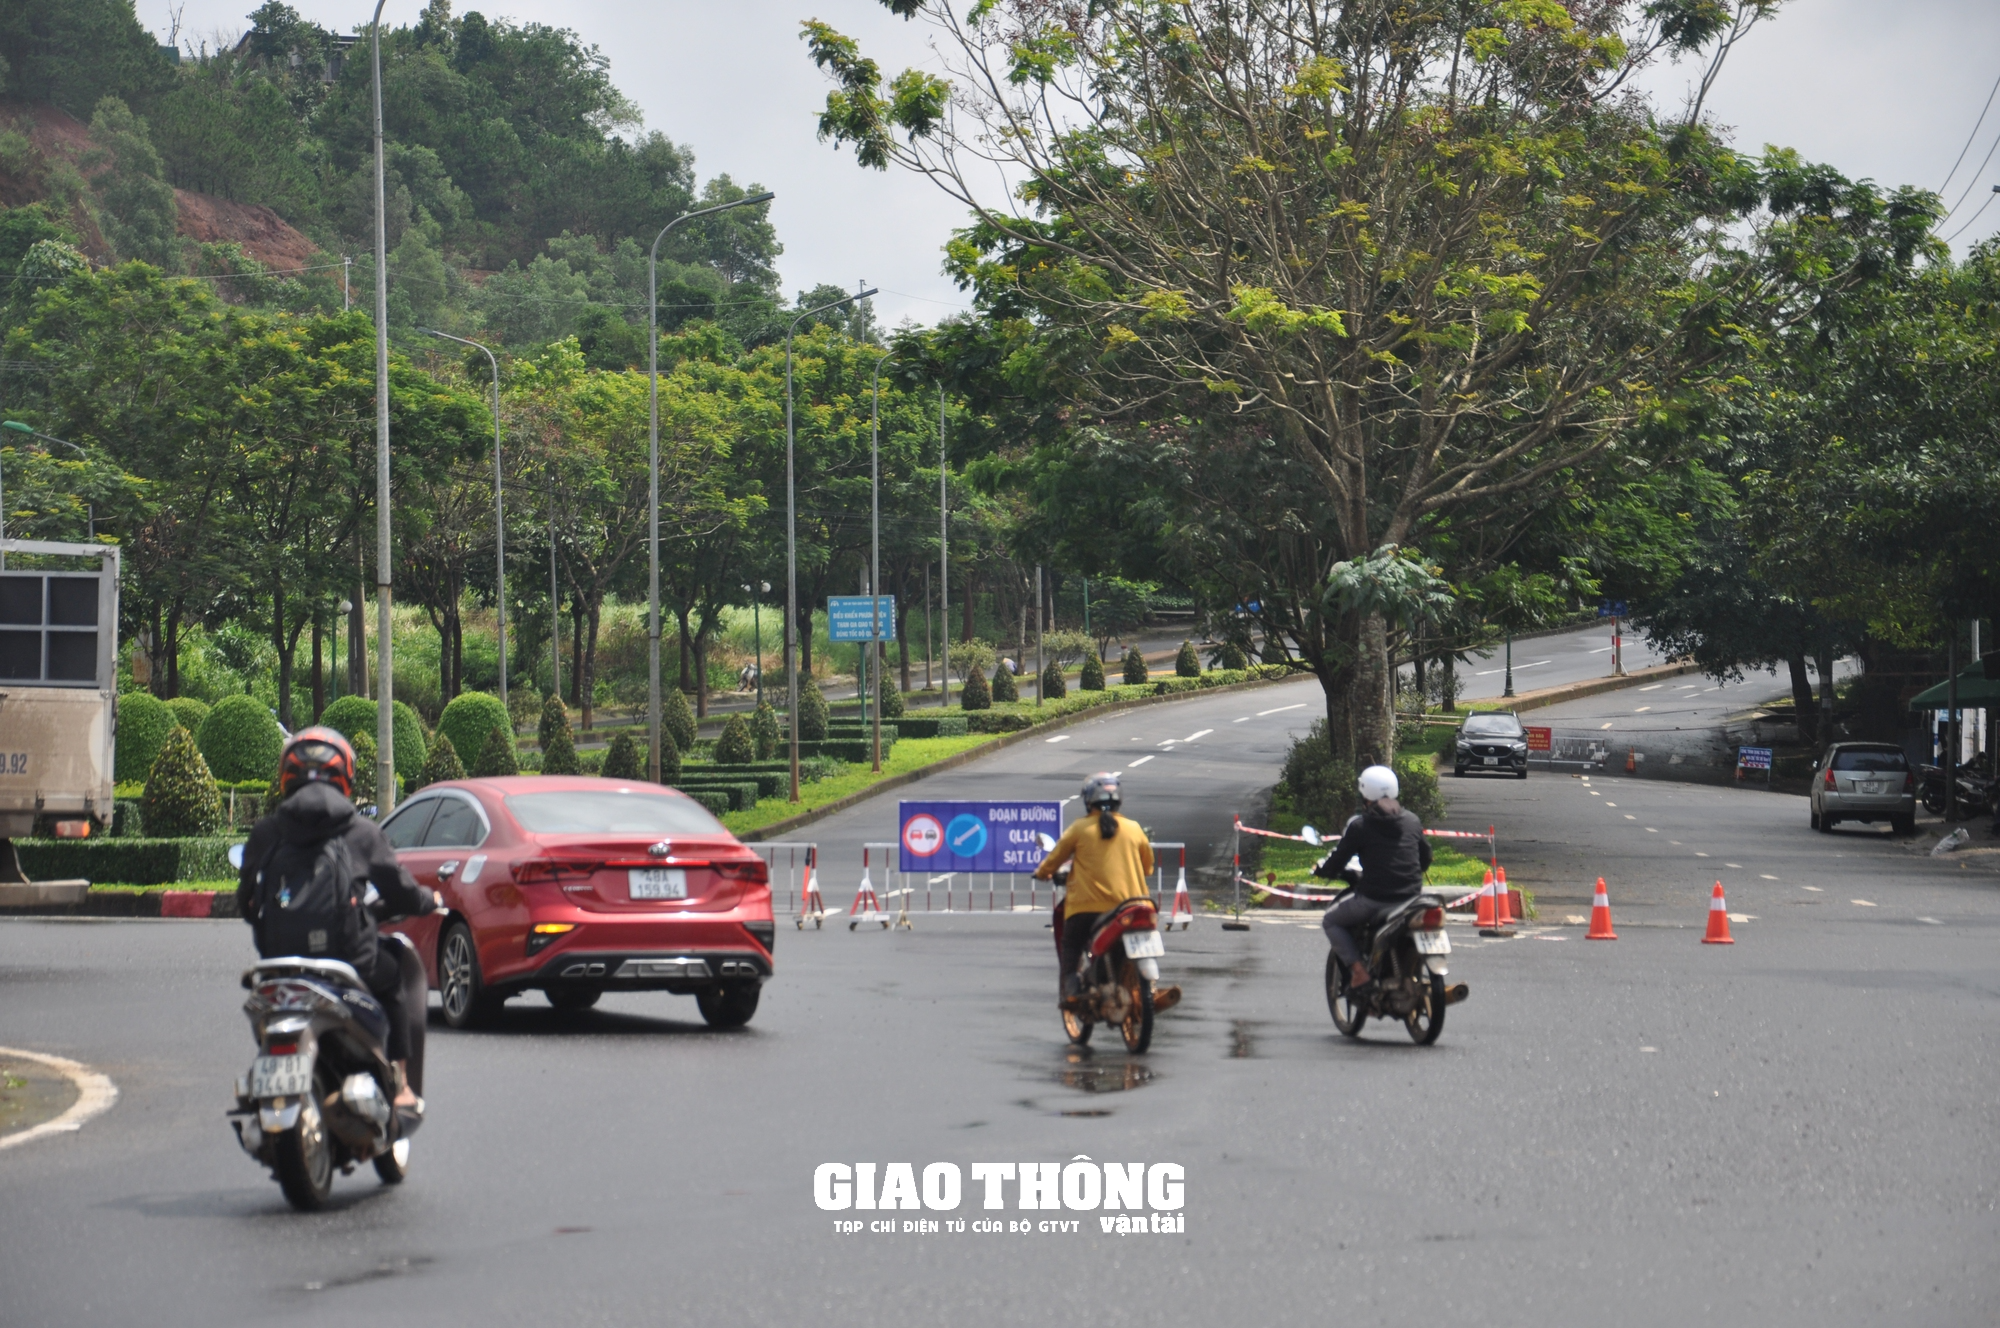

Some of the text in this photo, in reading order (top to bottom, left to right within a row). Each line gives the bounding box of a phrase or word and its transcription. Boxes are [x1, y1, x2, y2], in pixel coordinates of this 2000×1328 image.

[989, 805, 1057, 824] ĐOẠN ĐƯỜNG
[1009, 829, 1036, 843] QL14
[1003, 851, 1024, 866] SẠT
[645, 869, 670, 882] 48A
[637, 883, 680, 897] 159.94
